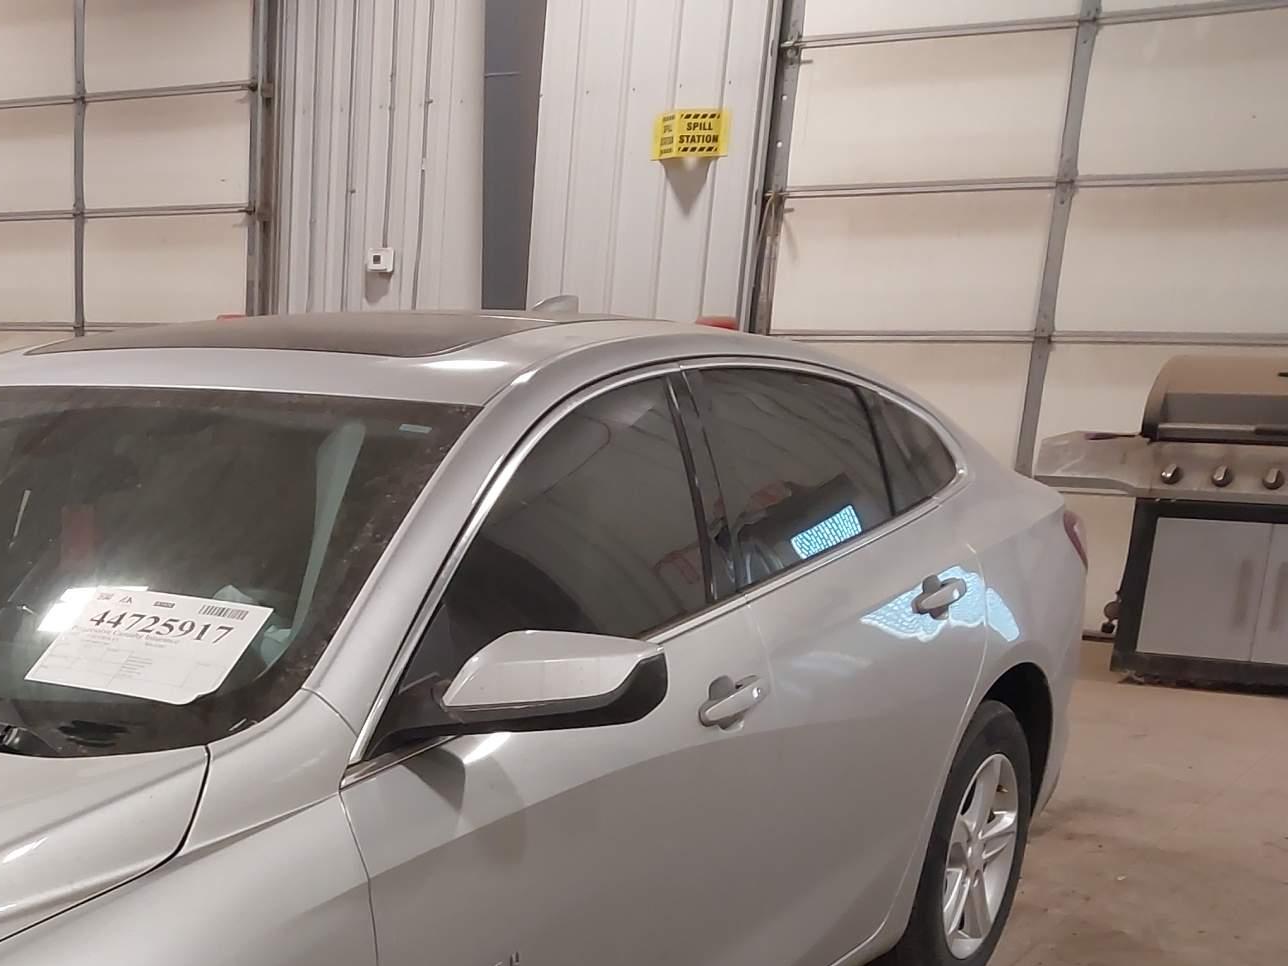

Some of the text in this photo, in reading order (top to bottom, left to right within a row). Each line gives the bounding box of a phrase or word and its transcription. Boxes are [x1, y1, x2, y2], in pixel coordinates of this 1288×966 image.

[686, 122, 713, 131] SPILL
[679, 134, 719, 143] STATION
[89, 609, 235, 644] 44725917
